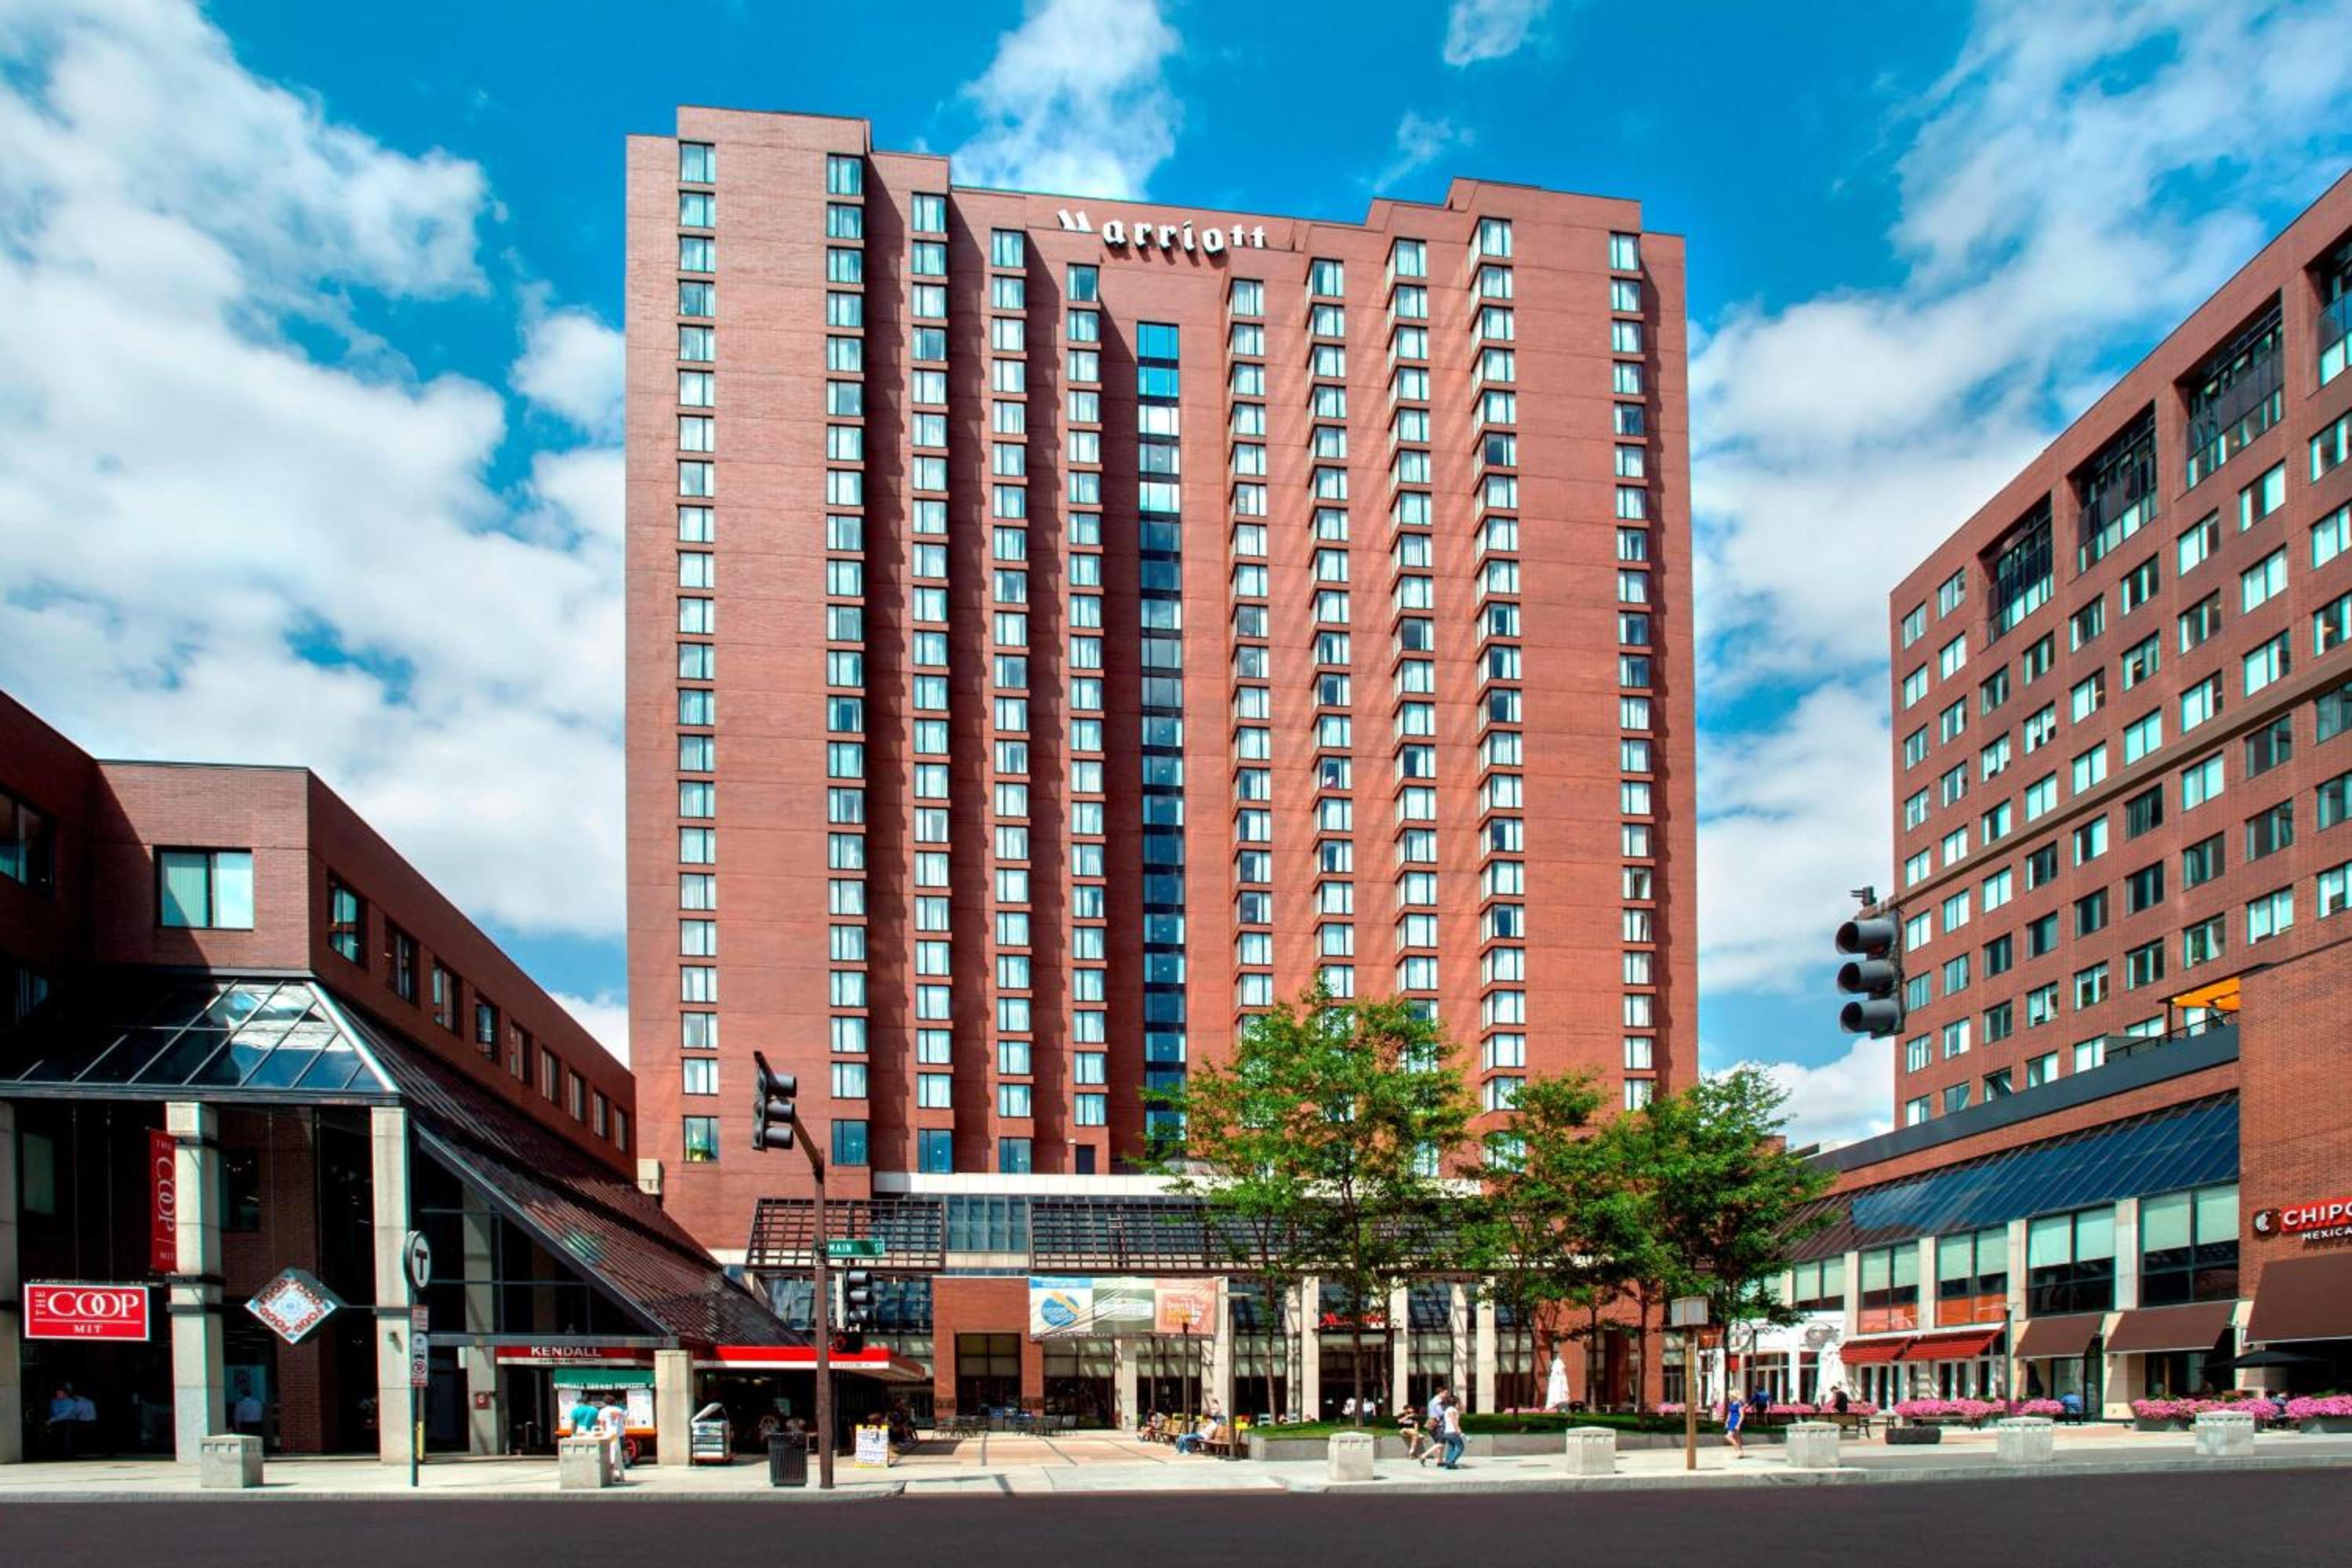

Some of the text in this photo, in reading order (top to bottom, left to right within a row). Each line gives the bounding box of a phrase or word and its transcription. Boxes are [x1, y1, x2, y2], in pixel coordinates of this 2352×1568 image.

[157, 1156, 175, 1232] COOP
[829, 1243, 884, 1254] MAIN ST
[416, 1249, 427, 1280] T
[34, 1290, 46, 1316] THE
[48, 1291, 140, 1318] COOP
[74, 1325, 103, 1334] MIT
[531, 1346, 601, 1357] KENDALL
